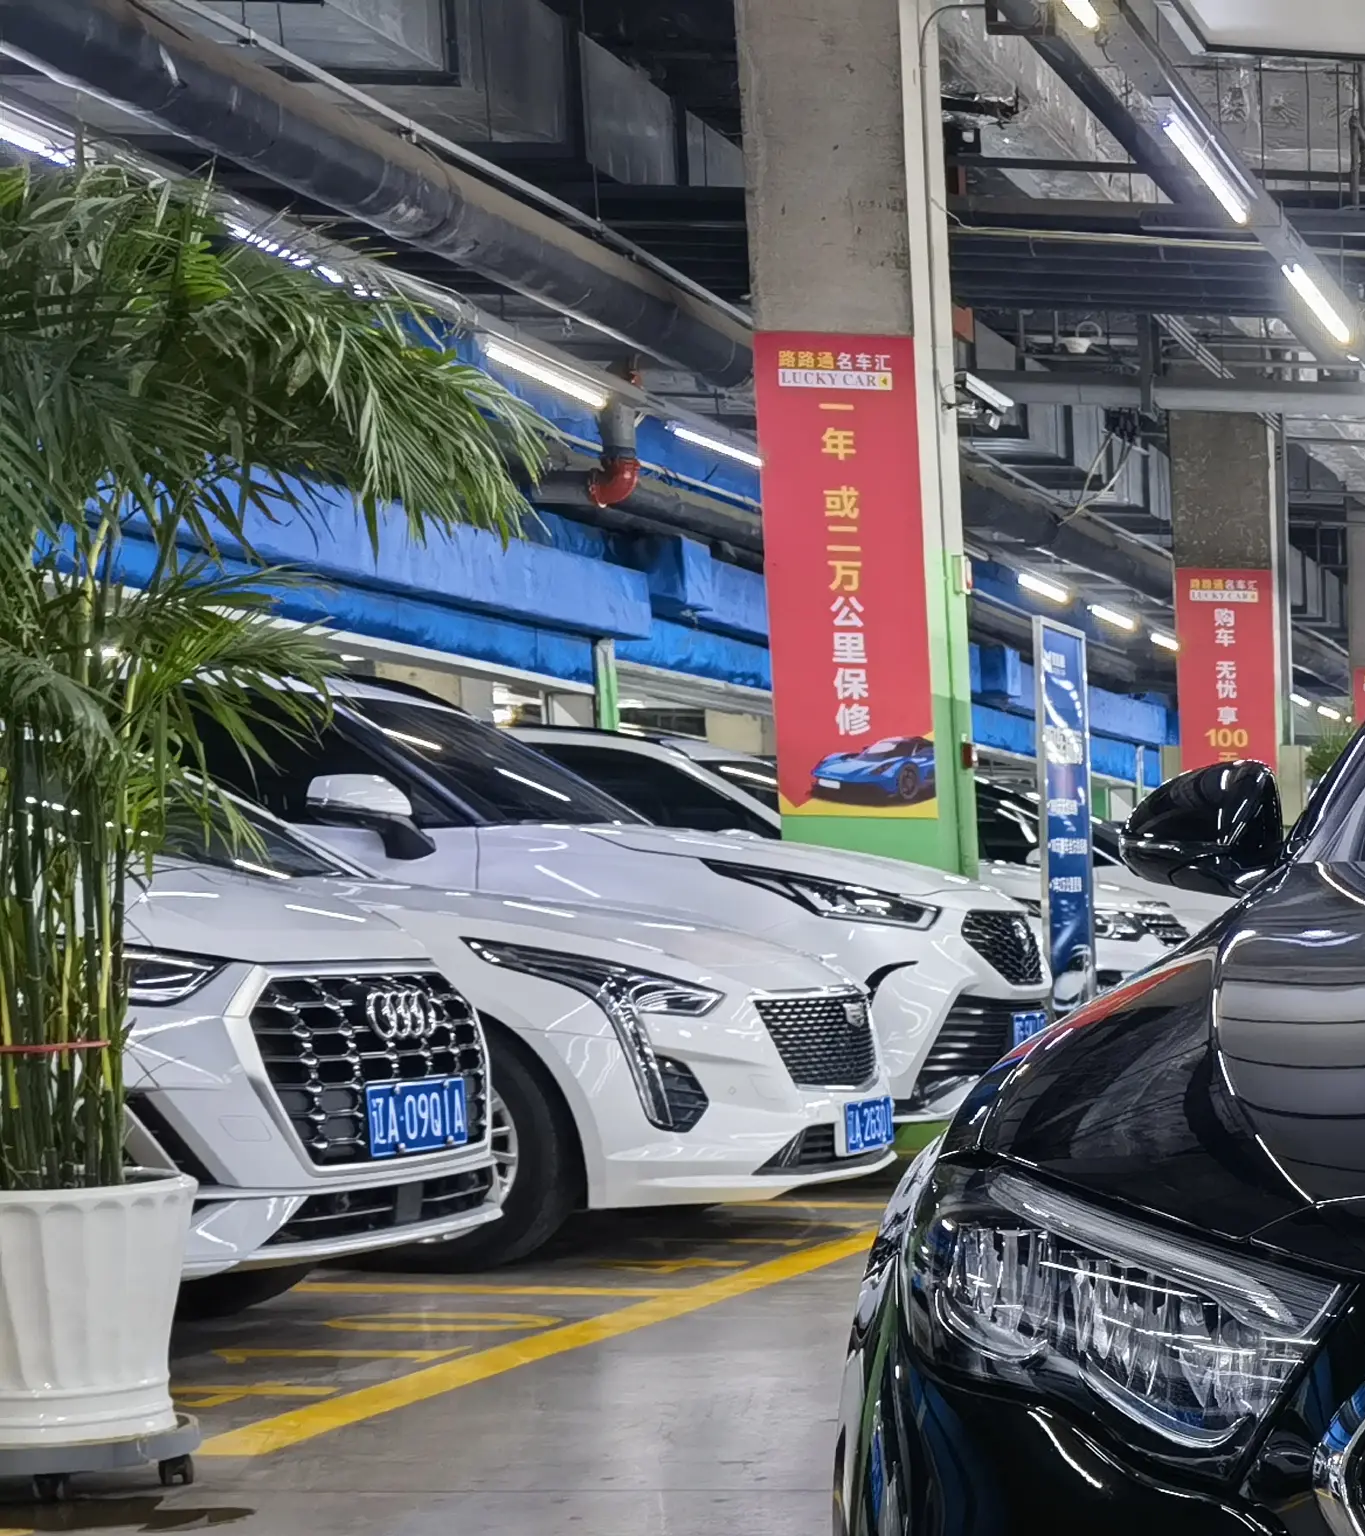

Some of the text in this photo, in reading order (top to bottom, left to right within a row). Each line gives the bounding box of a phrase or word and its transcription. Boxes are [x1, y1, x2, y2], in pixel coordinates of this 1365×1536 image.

[778, 350, 892, 372] 路路通名车汇
[781, 371, 877, 387] LUCKY CAR
